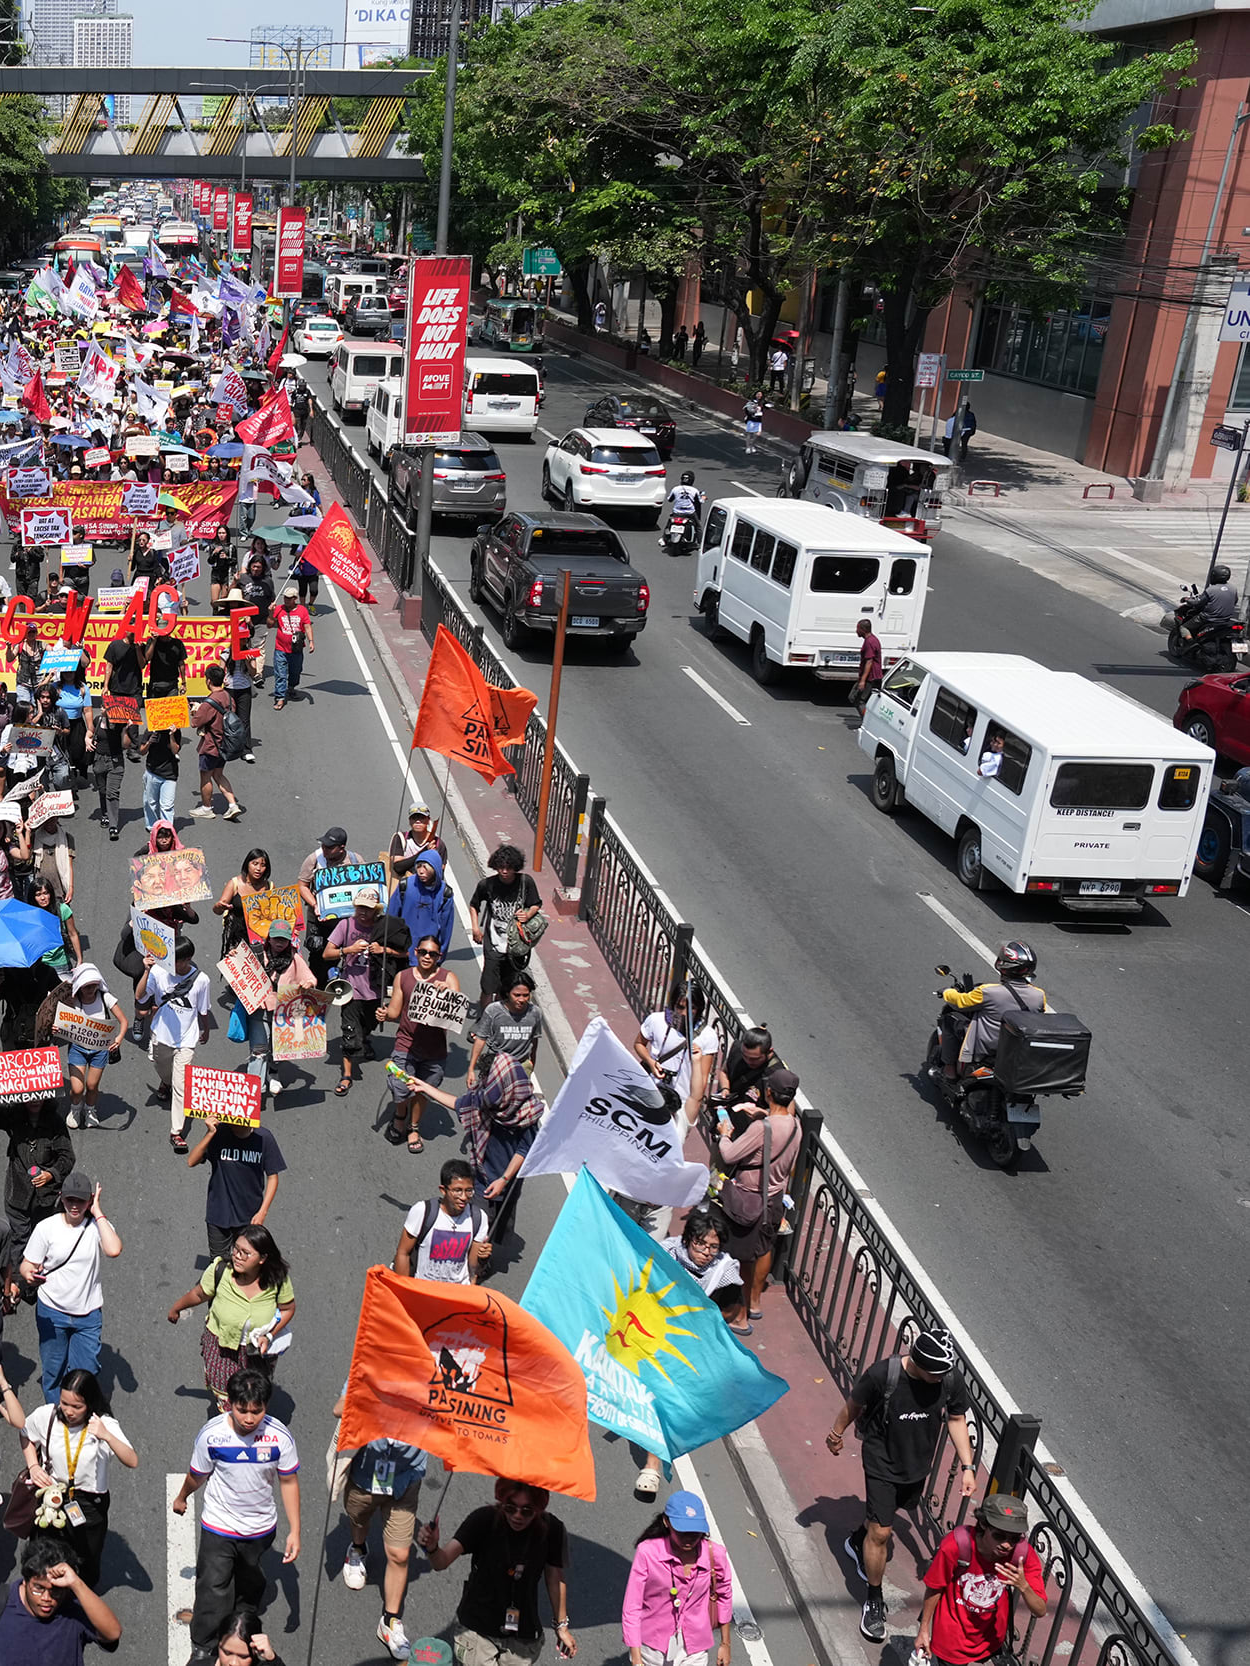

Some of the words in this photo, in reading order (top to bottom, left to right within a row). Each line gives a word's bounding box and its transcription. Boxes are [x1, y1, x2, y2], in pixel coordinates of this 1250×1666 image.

[376, 10, 397, 23] KA
[283, 221, 303, 231] KEEP
[422, 288, 461, 306] LIFE
[416, 306, 463, 324] DOES
[419, 324, 457, 342] NOT
[414, 342, 460, 360] WAIT
[422, 374, 451, 383] MOVE
[879, 704, 895, 718] JJK
[1056, 808, 1074, 816] KEEP
[1074, 808, 1115, 818] DISTANCE!
[1073, 841, 1110, 849] PRIVATE
[316, 864, 386, 891] MAKIBAKA
[1082, 882, 1097, 893] NKP
[1099, 882, 1121, 893] 6790
[414, 982, 435, 997] ANG
[435, 984, 470, 1010] LANGIS
[411, 996, 422, 1006] AY
[423, 997, 463, 1015] BUHAY!
[419, 1006, 428, 1014] TO
[429, 1009, 441, 1018] OIL
[441, 1012, 465, 1026] PRICE
[36, 1063, 63, 1076] KARTEL
[191, 1077, 258, 1097] MAKIBAKA!
[191, 1089, 248, 1107] BAGUHIN
[190, 1099, 255, 1118] SISTEMA!
[585, 1097, 672, 1159] SCM
[578, 1113, 660, 1164] PHILIPPINES
[220, 1149, 239, 1162] OLD
[241, 1150, 262, 1164] NAVY
[207, 1435, 233, 1445] Cegid
[254, 1434, 280, 1444] MDA
[472, 1430, 509, 1446] TOMAS
